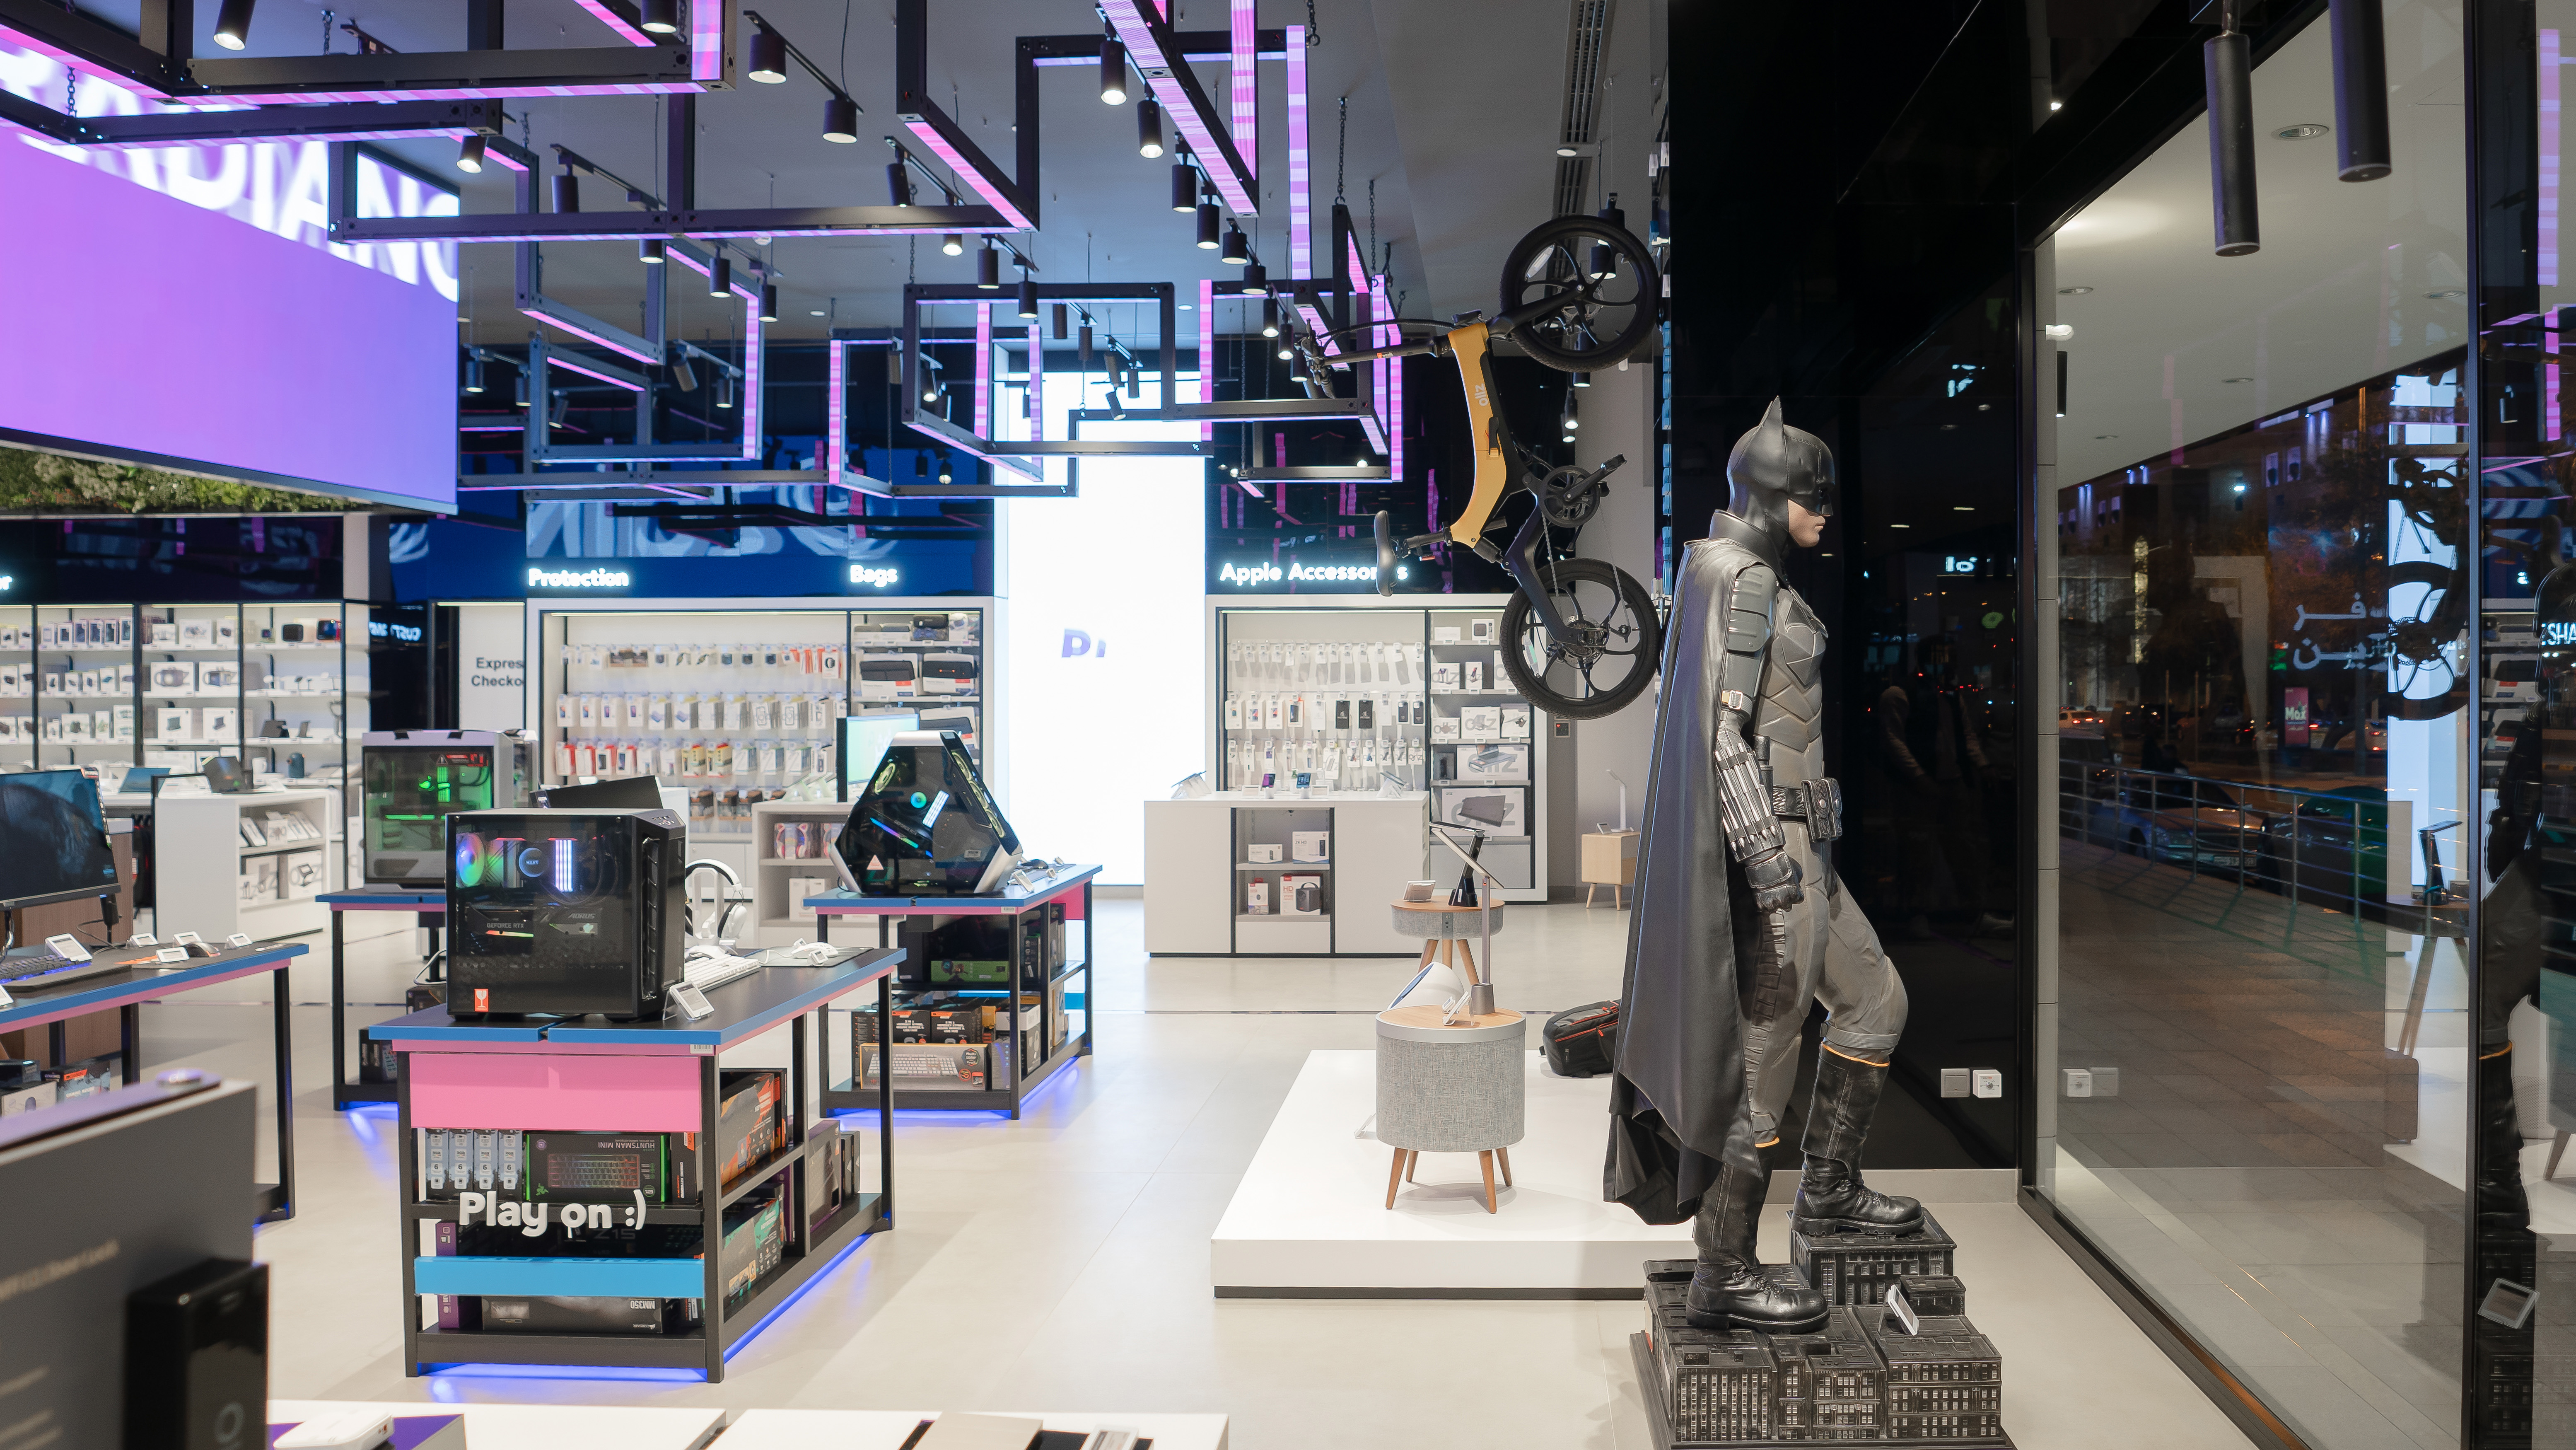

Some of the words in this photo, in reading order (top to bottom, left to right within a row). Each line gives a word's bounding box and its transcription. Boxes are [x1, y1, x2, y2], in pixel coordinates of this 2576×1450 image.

[1474, 383, 1488, 407] ollz
[528, 568, 629, 587] Protection
[849, 564, 898, 587] Bags
[1219, 562, 1282, 586] Apple
[1288, 562, 1408, 580] Accessors
[476, 657, 525, 671] Expres
[471, 674, 525, 687] Checko
[459, 1190, 548, 1237] Play
[560, 1203, 613, 1229] on
[593, 1229, 636, 1240] Z15
[630, 1300, 656, 1309] MM350
